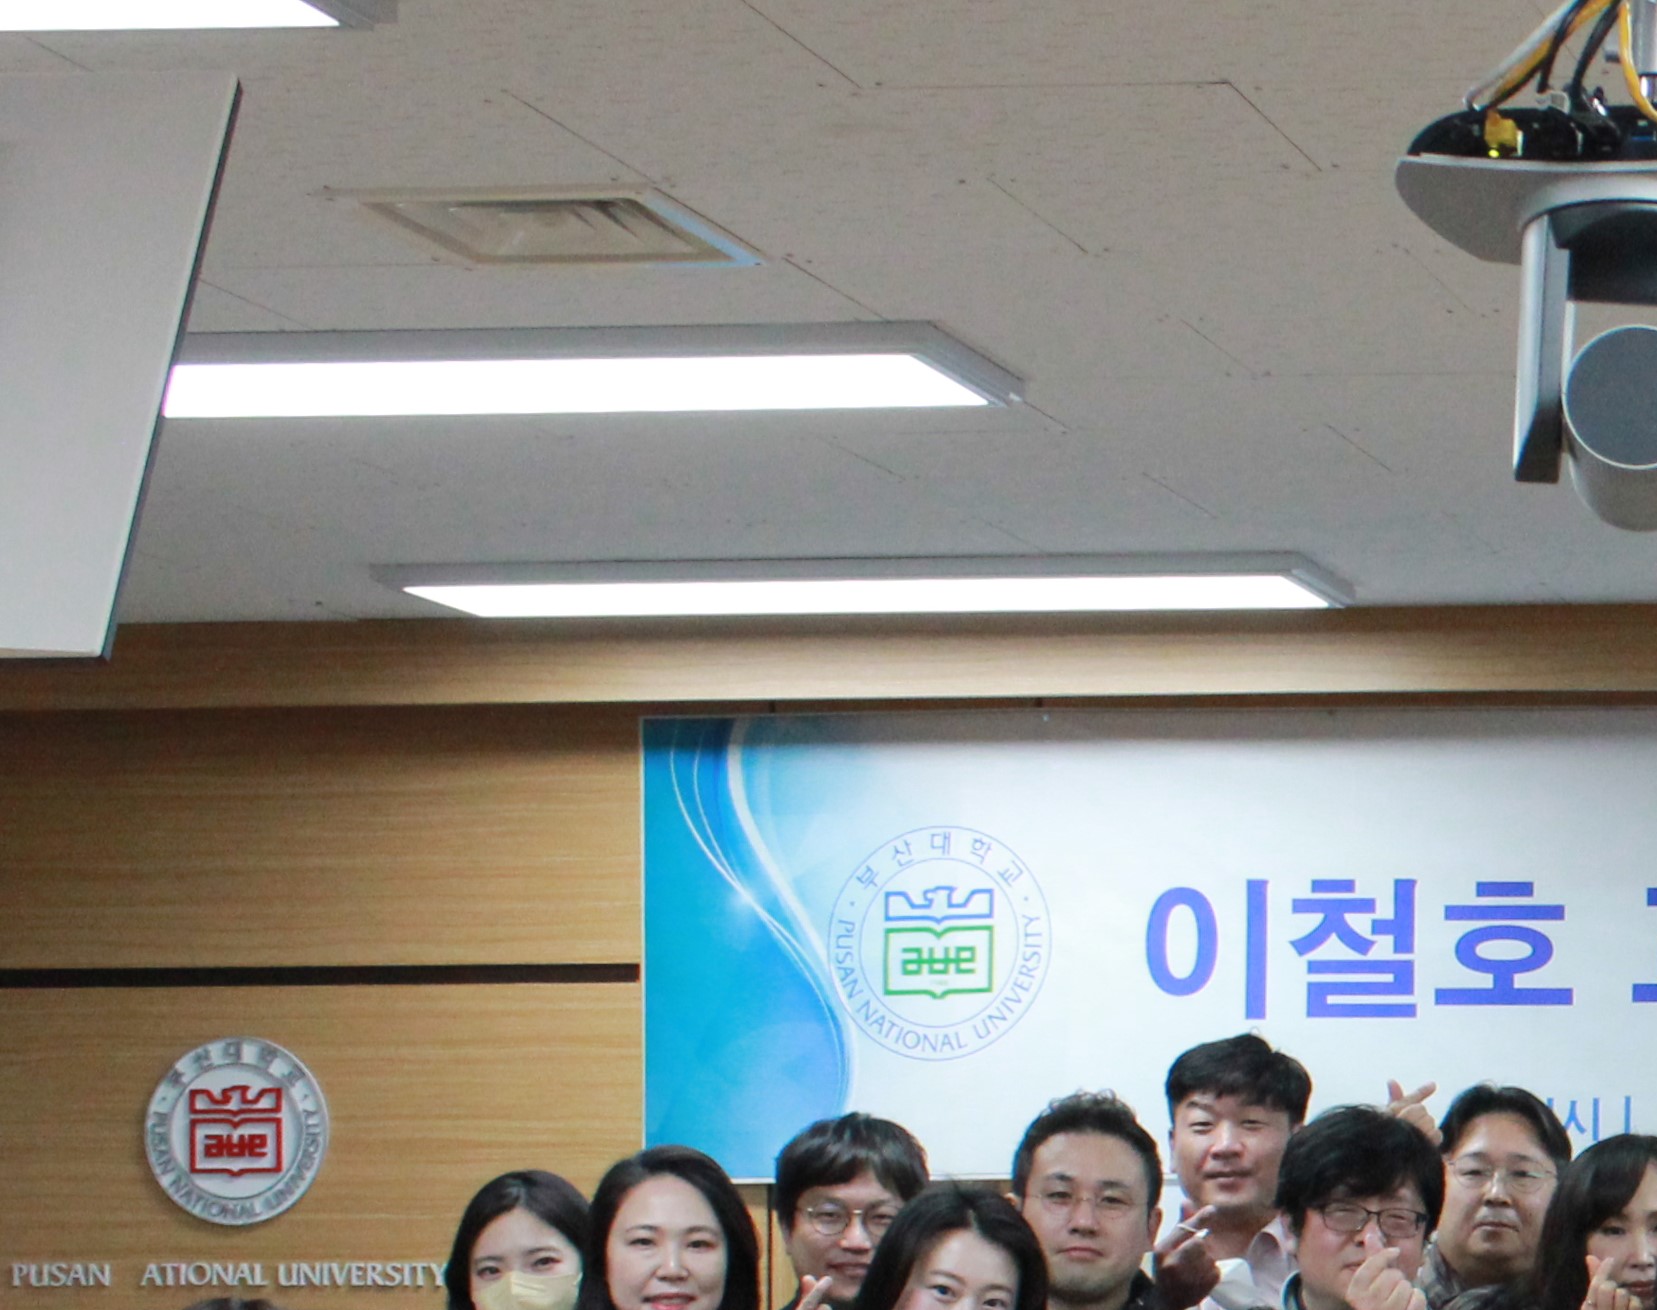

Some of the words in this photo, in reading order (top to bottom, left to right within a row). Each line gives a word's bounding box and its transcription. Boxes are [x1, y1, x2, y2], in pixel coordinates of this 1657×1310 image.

[856, 832, 1024, 890] 부산대학교
[834, 918, 864, 1000] PUSAN
[856, 998, 969, 1053] NATIONAL
[972, 914, 1043, 1040] UNIVERSITY
[1145, 878, 1572, 1021] 이철호
[12, 1262, 113, 1288] PUSAN
[278, 1262, 448, 1288] UNIVERSITY
